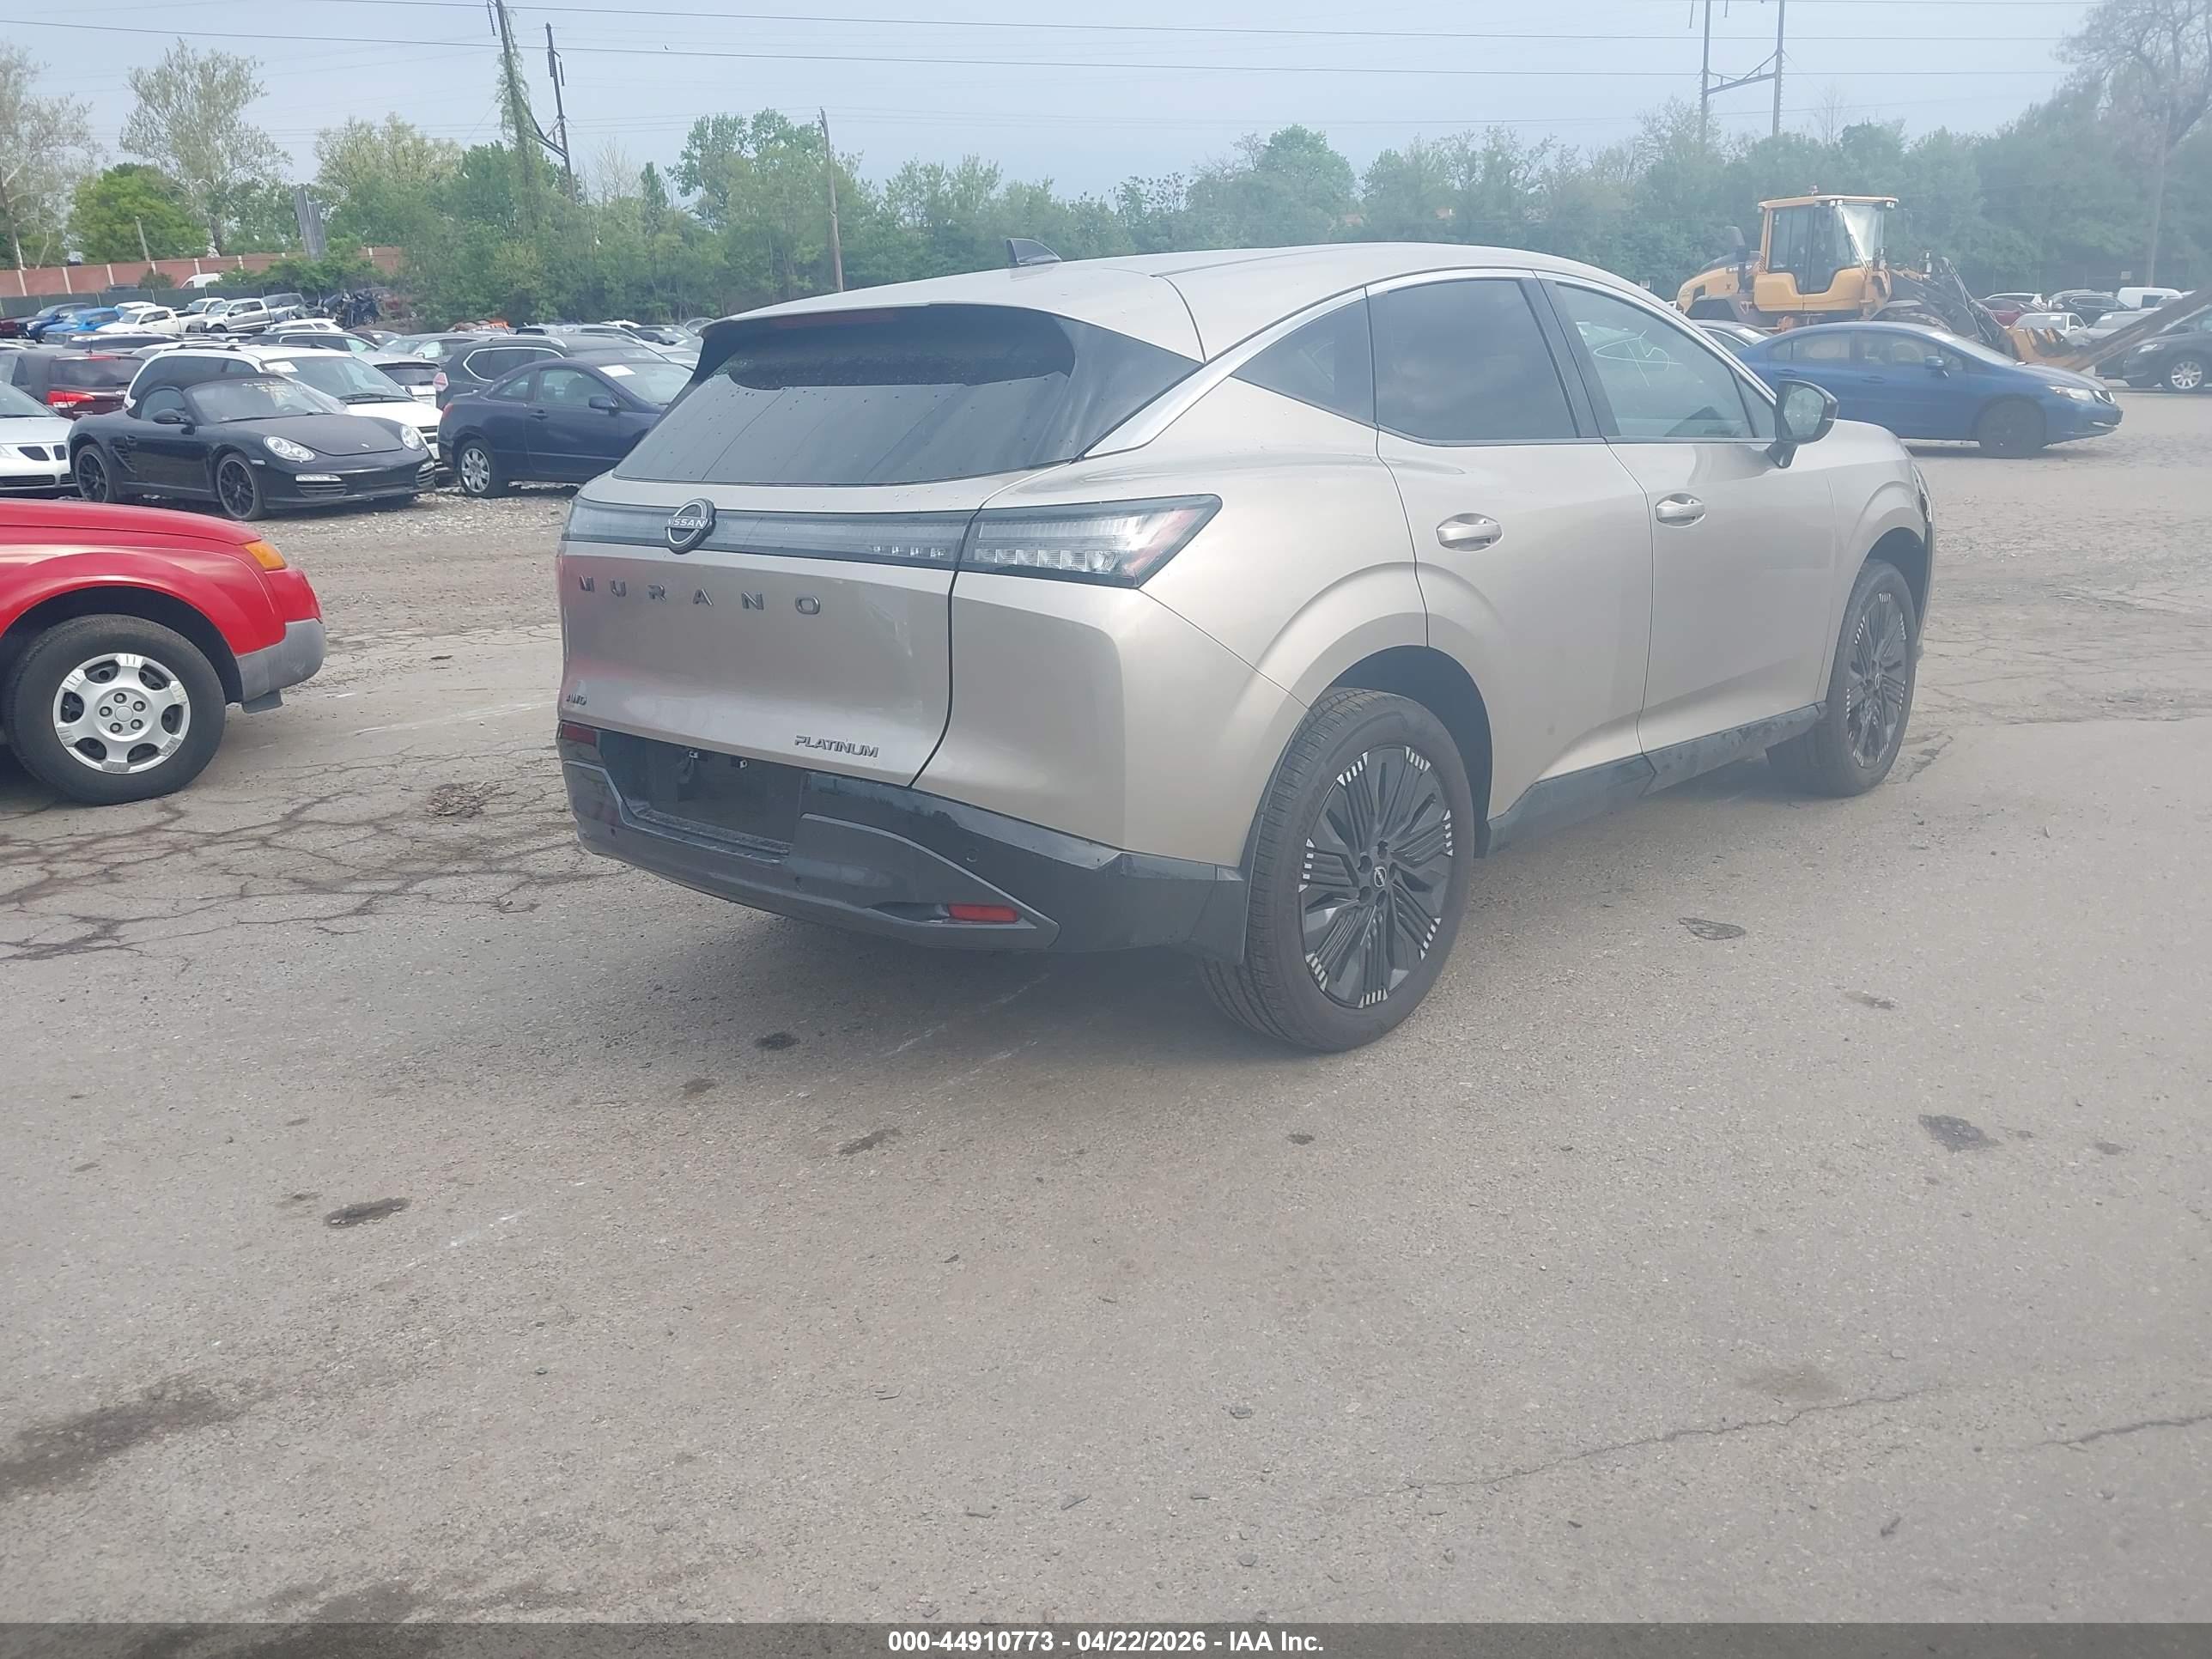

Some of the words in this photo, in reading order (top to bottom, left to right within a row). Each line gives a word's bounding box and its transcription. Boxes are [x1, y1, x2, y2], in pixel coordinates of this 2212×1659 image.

[667, 517, 707, 528] NISSAN
[579, 574, 821, 616] MURANO
[794, 734, 879, 758] PLATINUM
